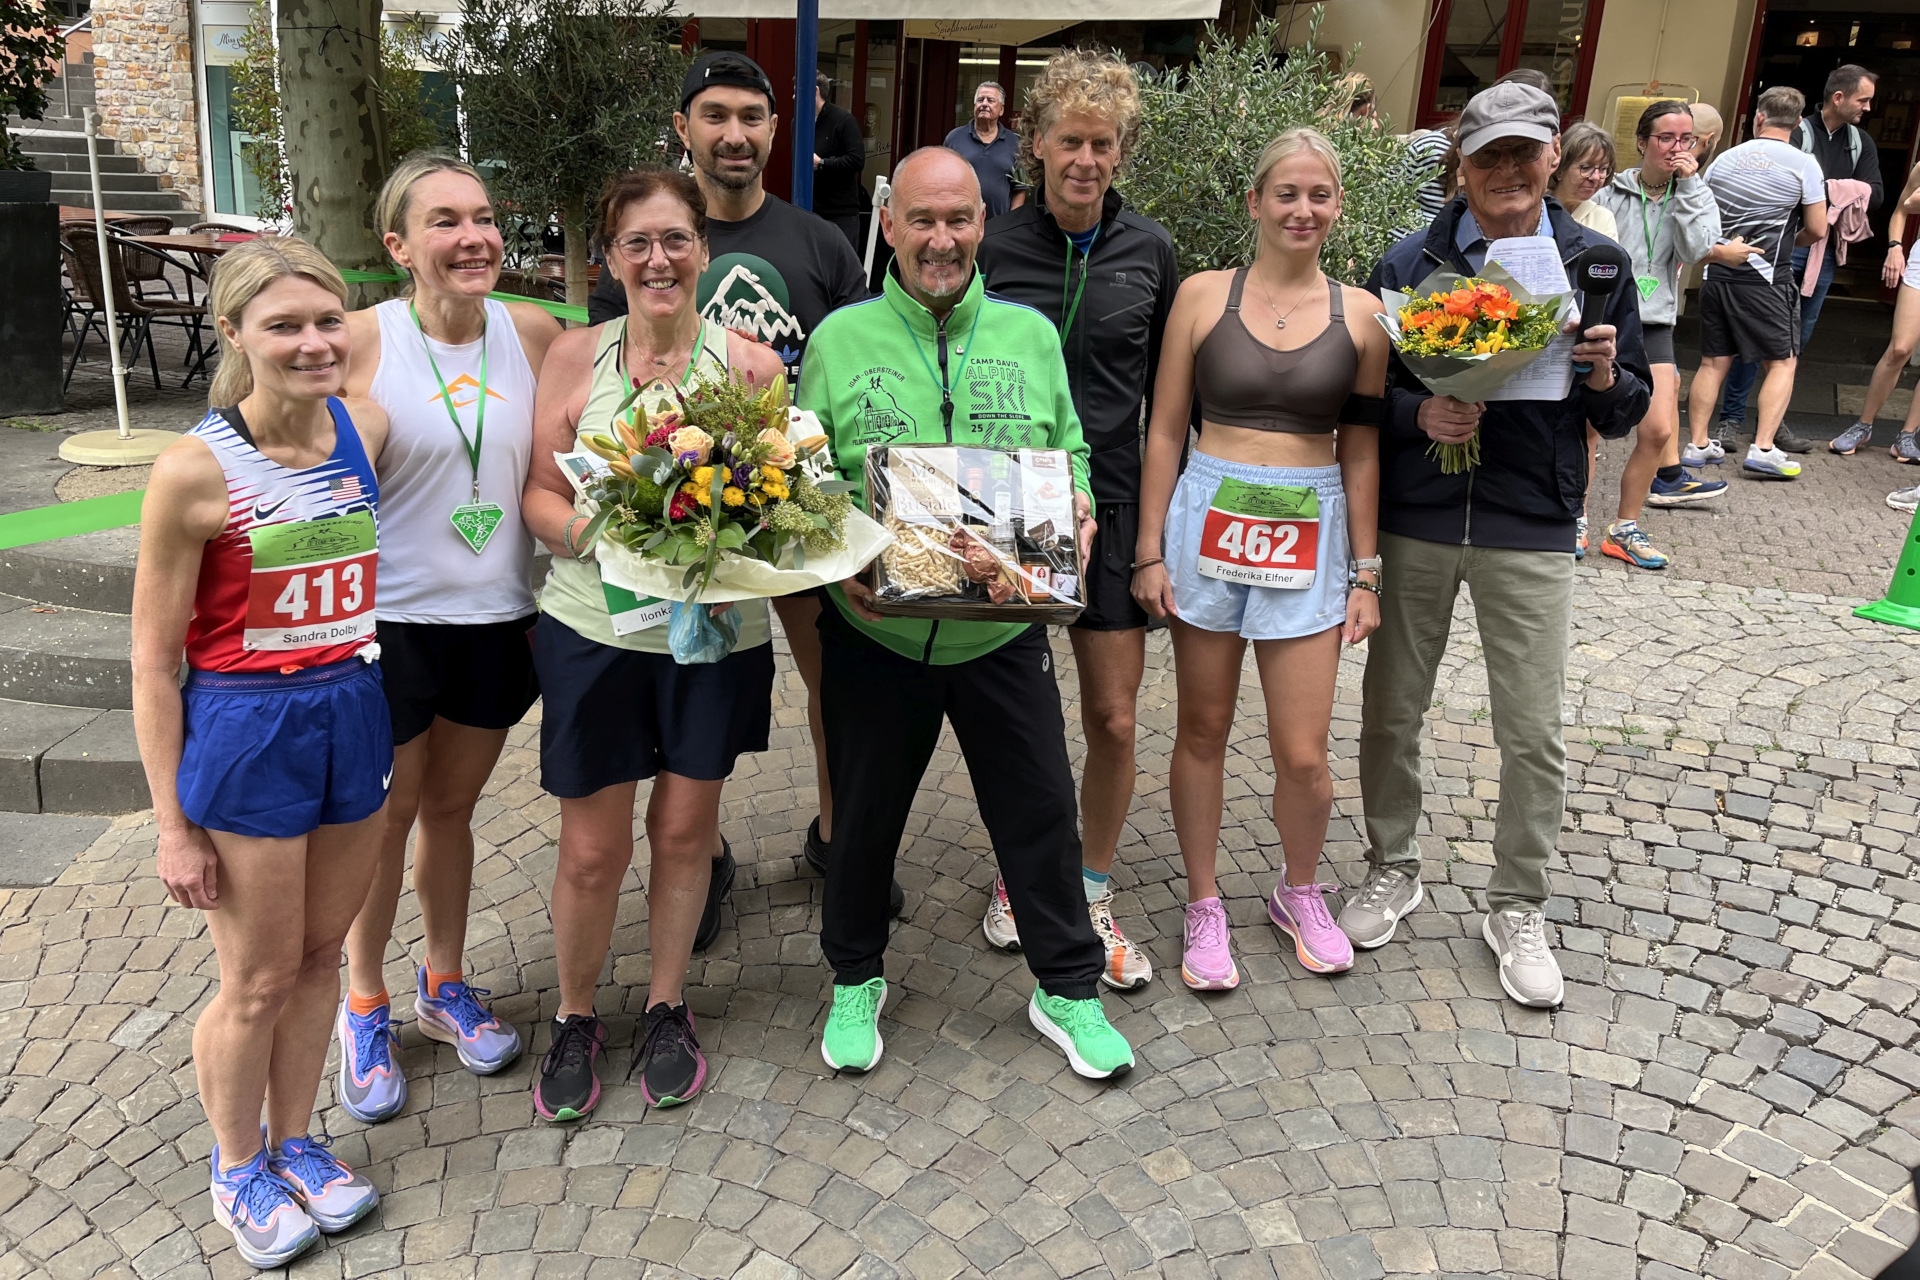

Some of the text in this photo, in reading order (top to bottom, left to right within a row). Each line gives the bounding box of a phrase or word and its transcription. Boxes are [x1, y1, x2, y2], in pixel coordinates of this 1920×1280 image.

[996, 360, 1019, 368] DAVID
[965, 366, 1027, 385] ALPINE
[970, 380, 1027, 412] SKI
[971, 424, 984, 433] 25
[1217, 520, 1299, 564] 462
[1216, 565, 1294, 583] Frederika Elfner
[274, 562, 364, 621] 413
[283, 624, 358, 644] Sandra Dolby
